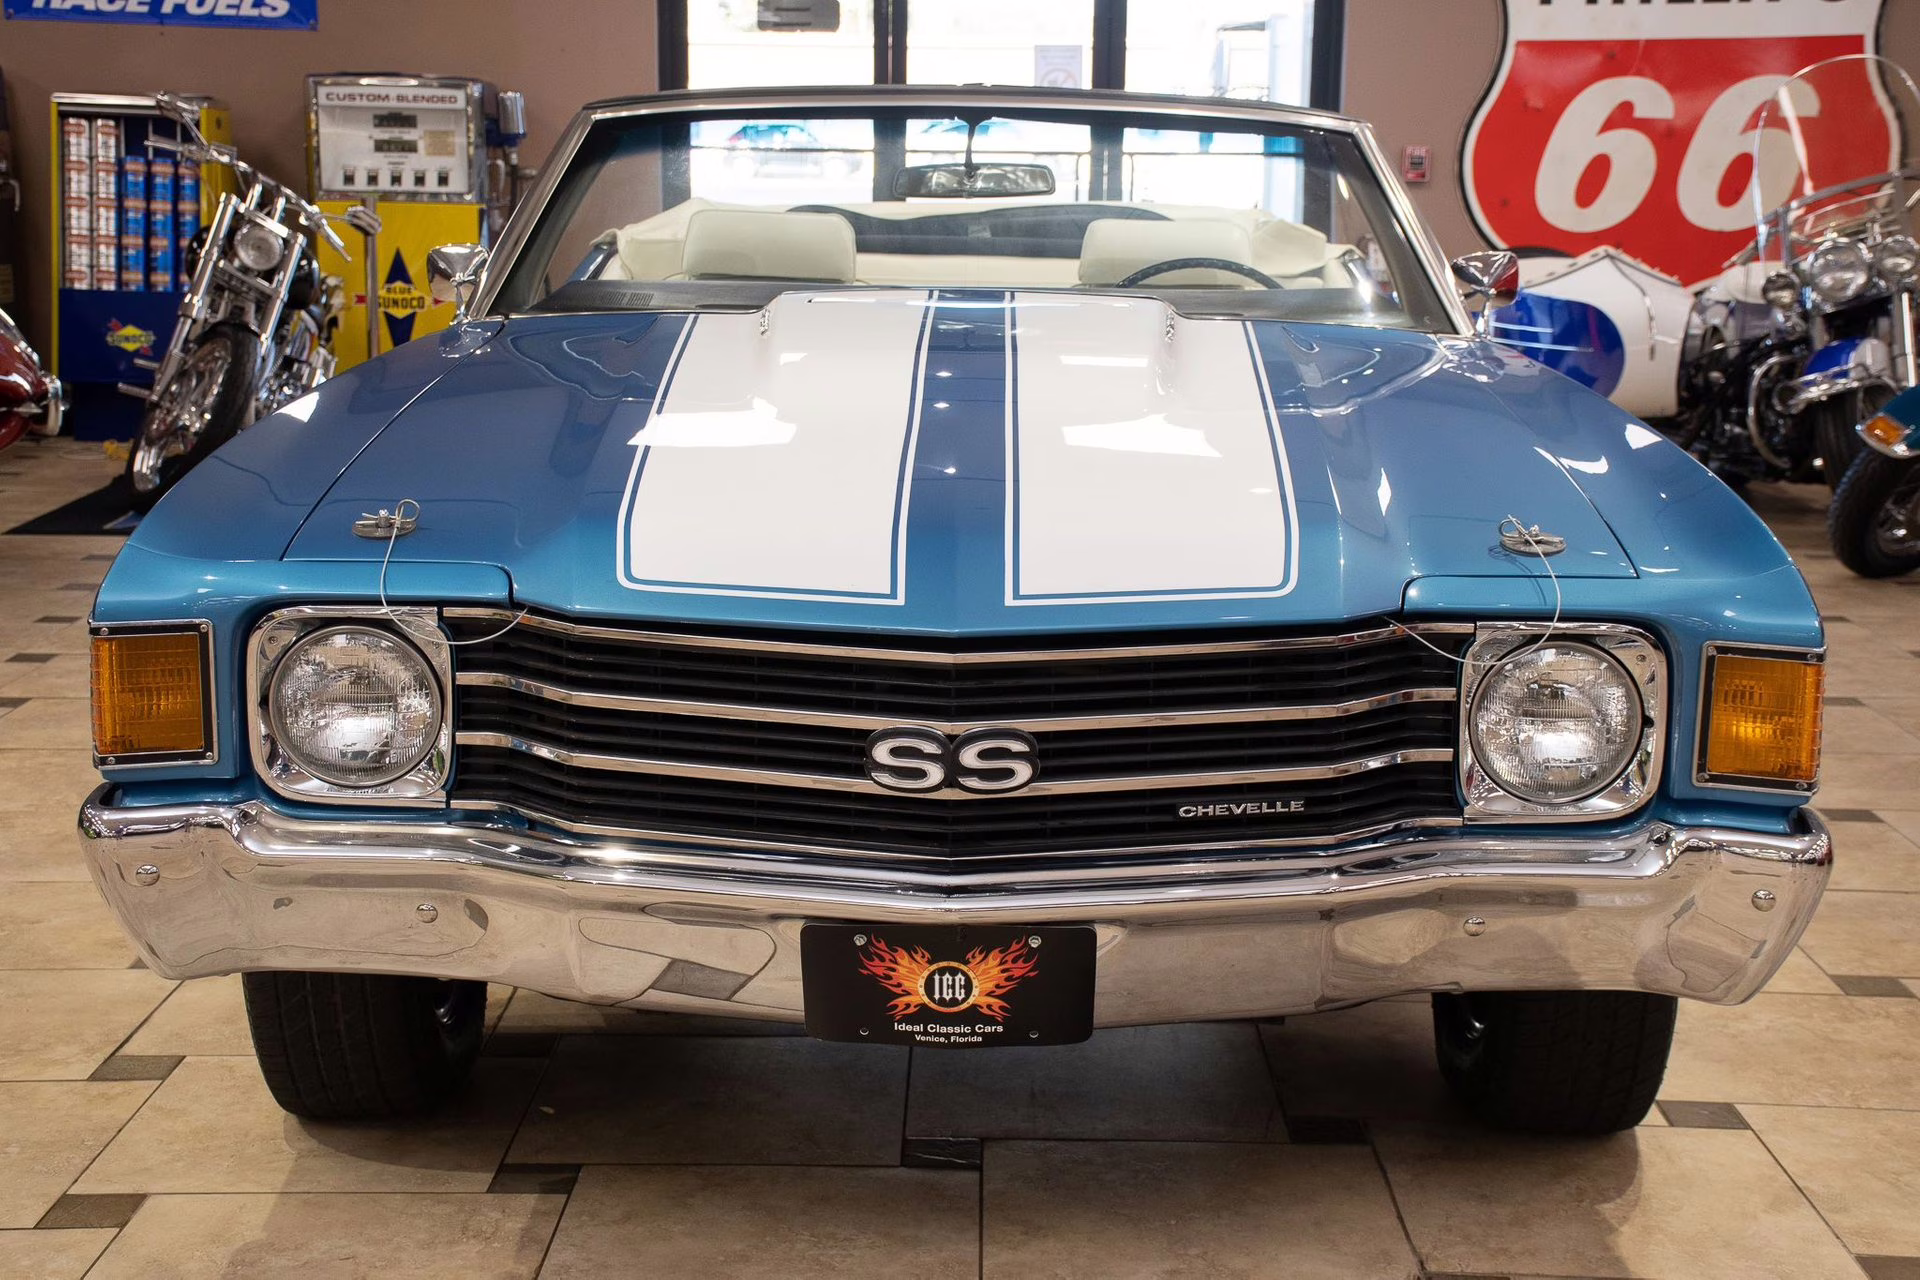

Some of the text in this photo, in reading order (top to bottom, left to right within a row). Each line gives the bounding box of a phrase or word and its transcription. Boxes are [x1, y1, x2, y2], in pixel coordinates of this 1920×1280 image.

[160, 0, 291, 18] FUELS
[1535, 75, 1820, 233] 66
[870, 737, 1034, 791] SS
[1179, 800, 1305, 817] CHEVELLE
[894, 1022, 1004, 1034] Ideal Classic Cars
[915, 1034, 983, 1044] Venice, Florida
